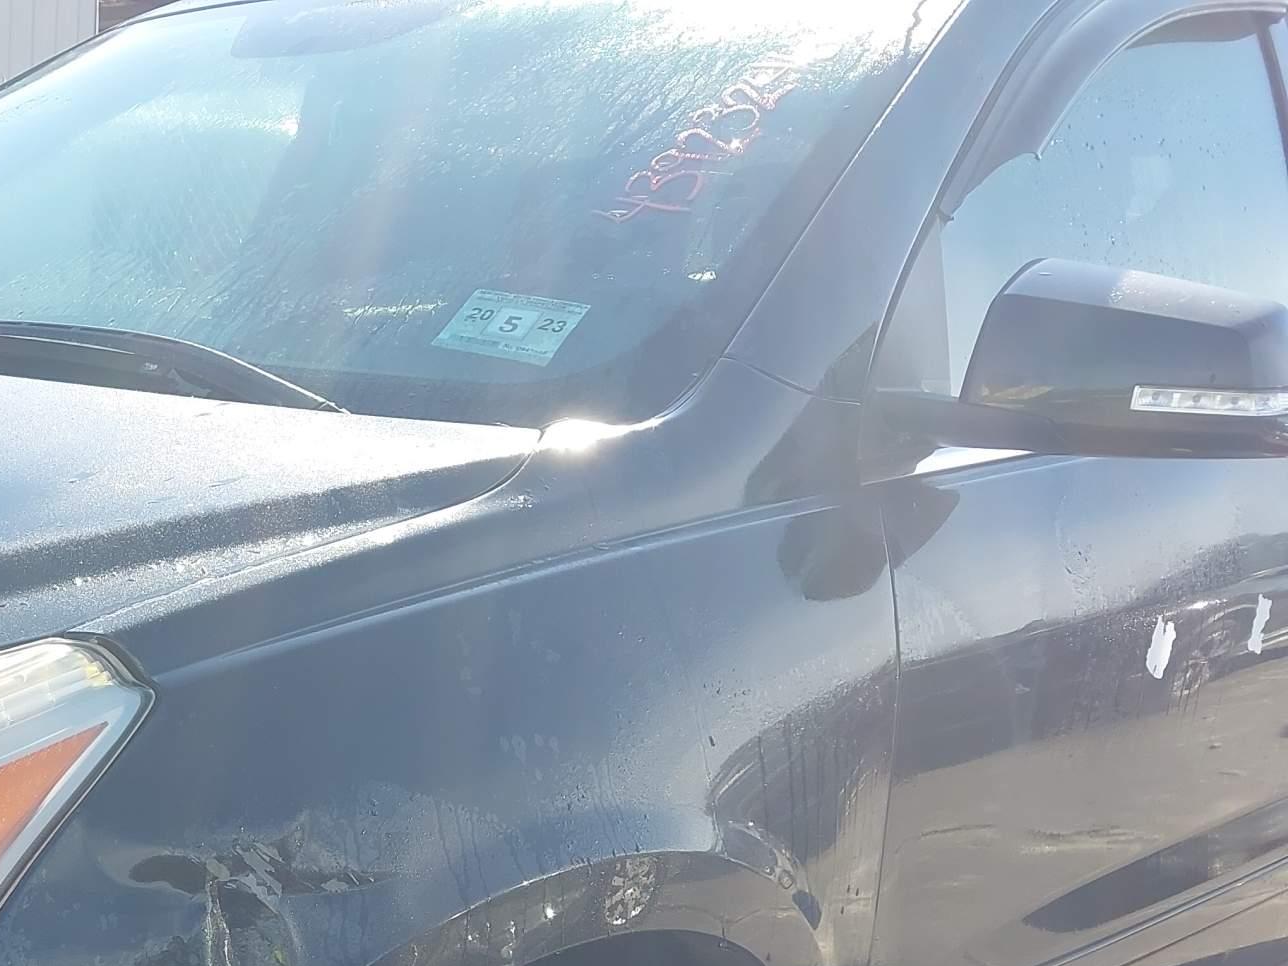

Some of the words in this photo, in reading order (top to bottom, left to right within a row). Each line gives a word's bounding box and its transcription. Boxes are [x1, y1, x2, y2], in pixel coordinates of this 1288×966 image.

[466, 307, 495, 321] 20
[498, 315, 523, 333] 5
[537, 317, 568, 333] 23
